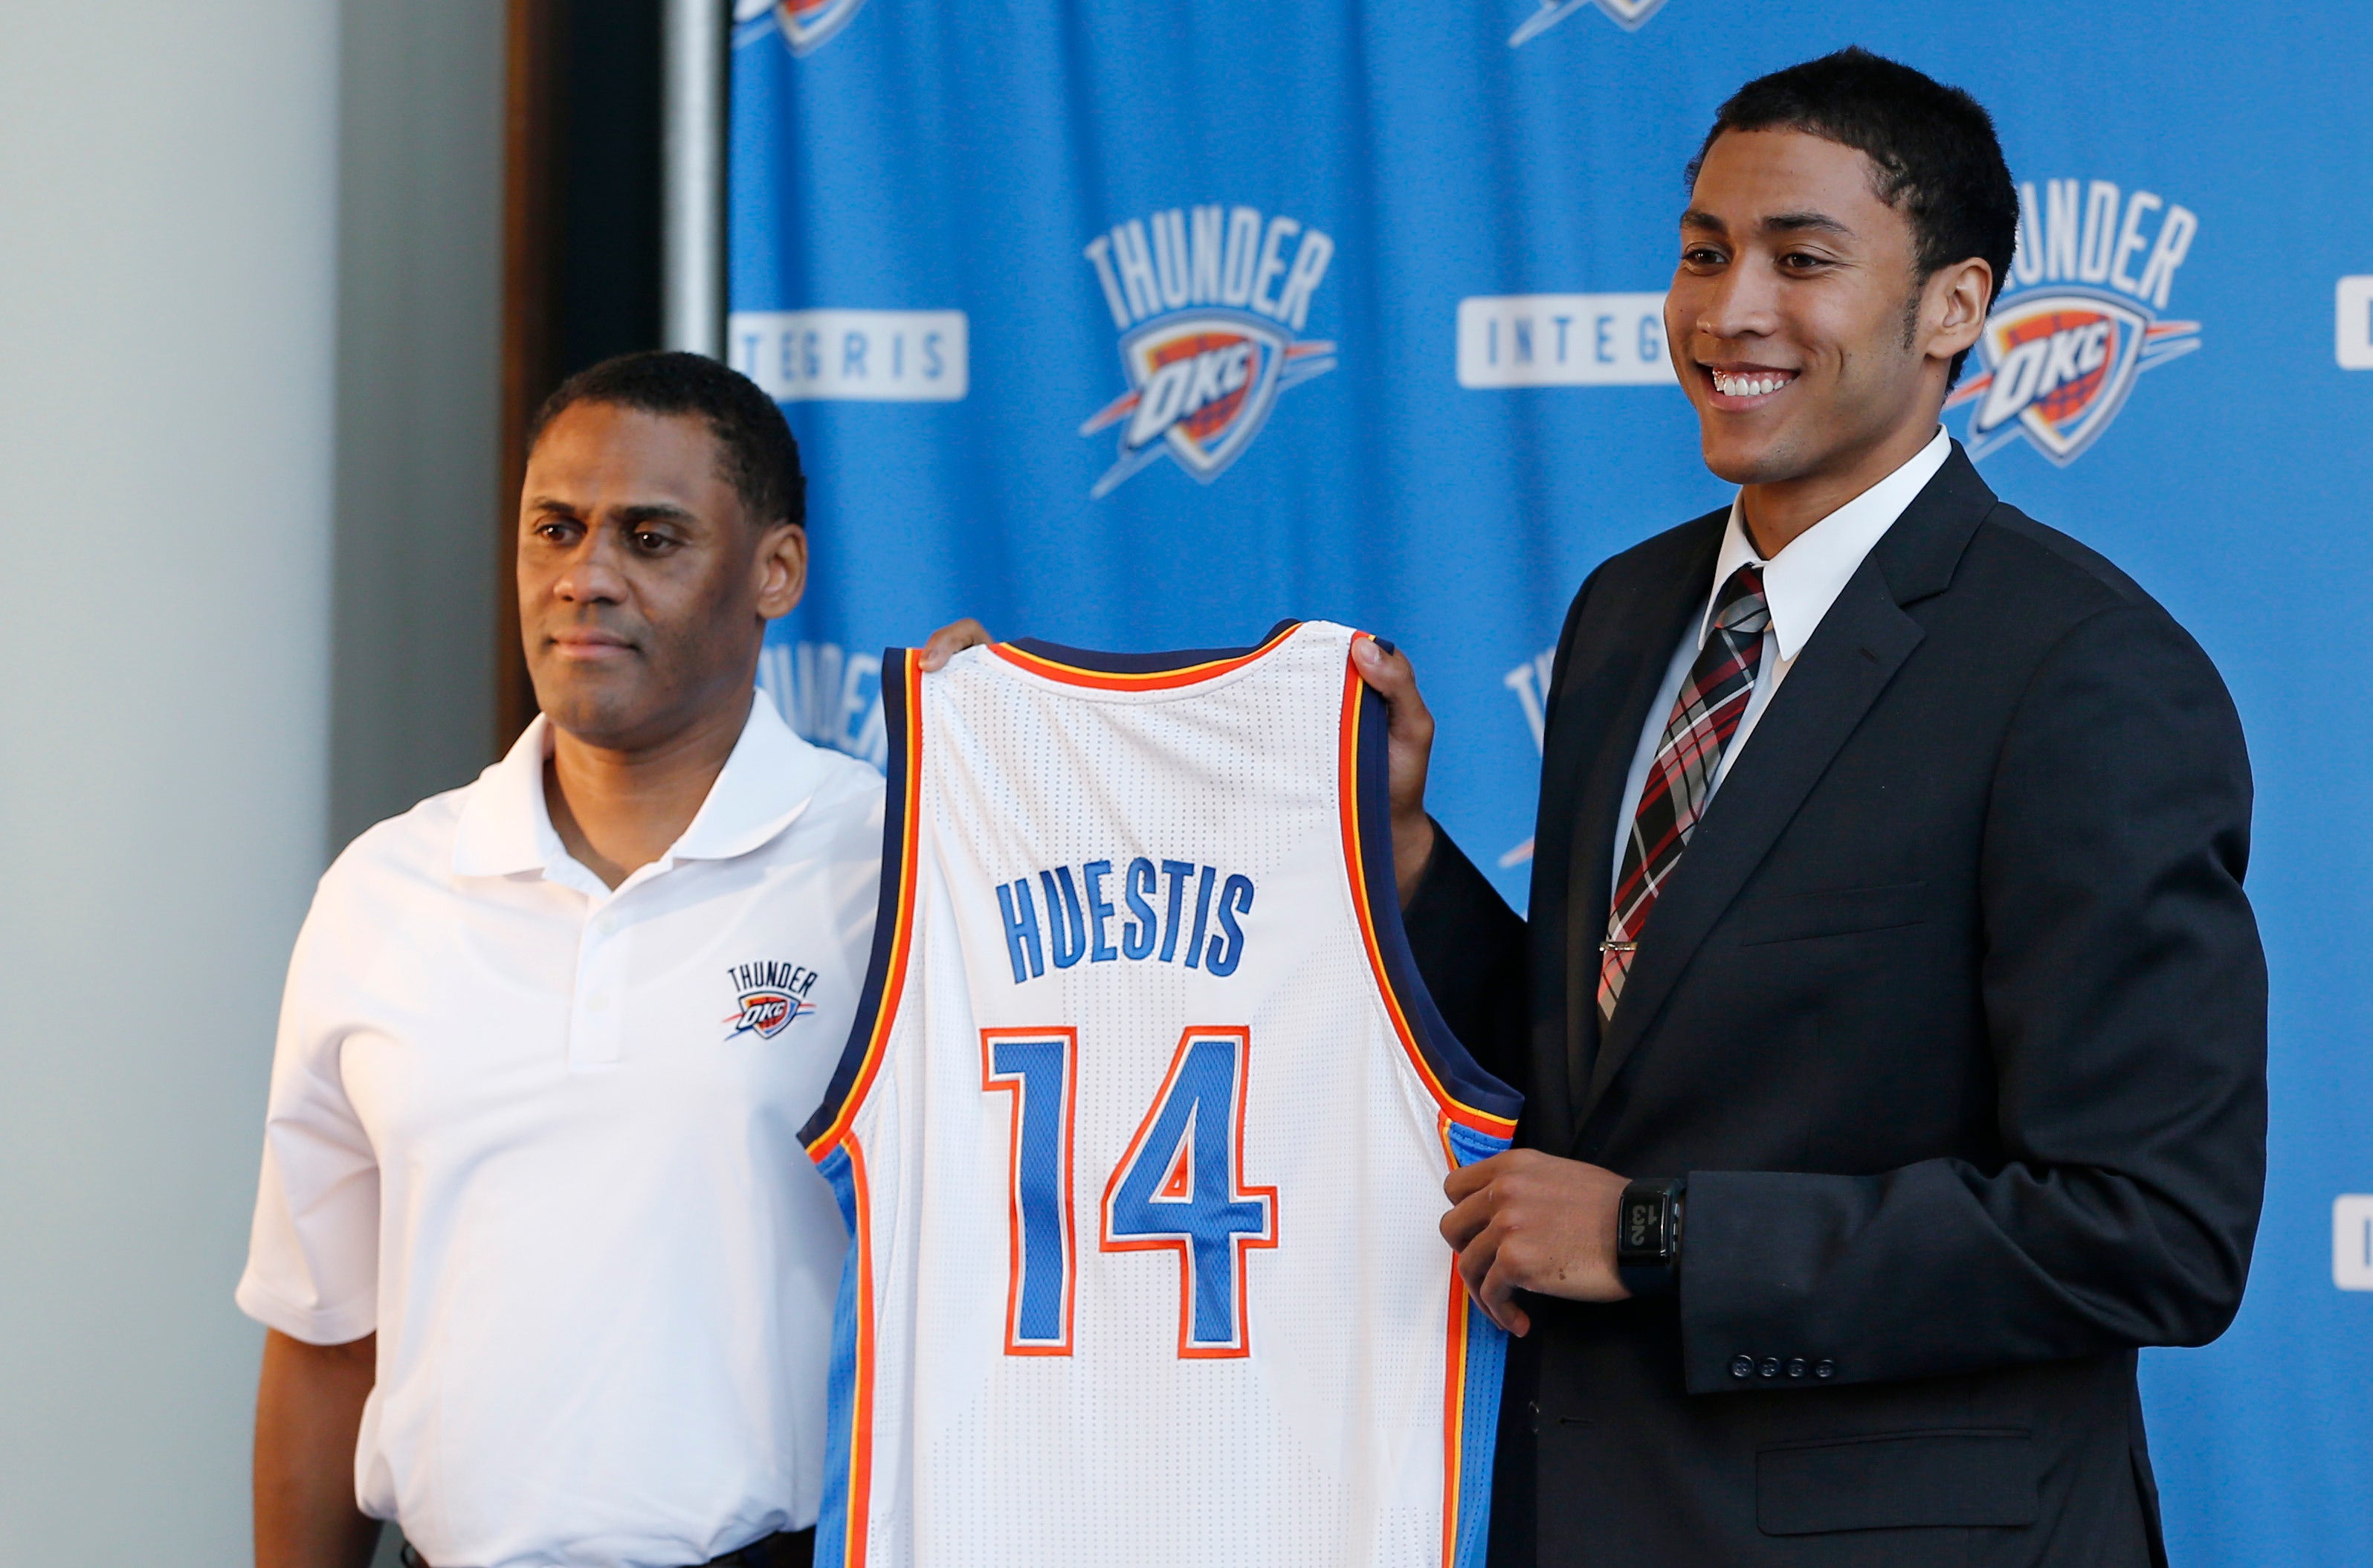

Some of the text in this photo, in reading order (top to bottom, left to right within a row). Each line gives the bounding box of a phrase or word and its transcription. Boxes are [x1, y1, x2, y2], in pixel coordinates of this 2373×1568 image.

[1083, 204, 1335, 330] THUNDER
[2005, 178, 2198, 310] UNDER
[1127, 342, 1253, 446] OKC
[1488, 314, 1660, 364] INTEG
[1978, 320, 2111, 431] OKC
[995, 857, 1254, 984] HUESTIS
[727, 961, 818, 998] THUNDER
[736, 999, 787, 1029] OKC
[980, 1025, 1279, 1359] 14
